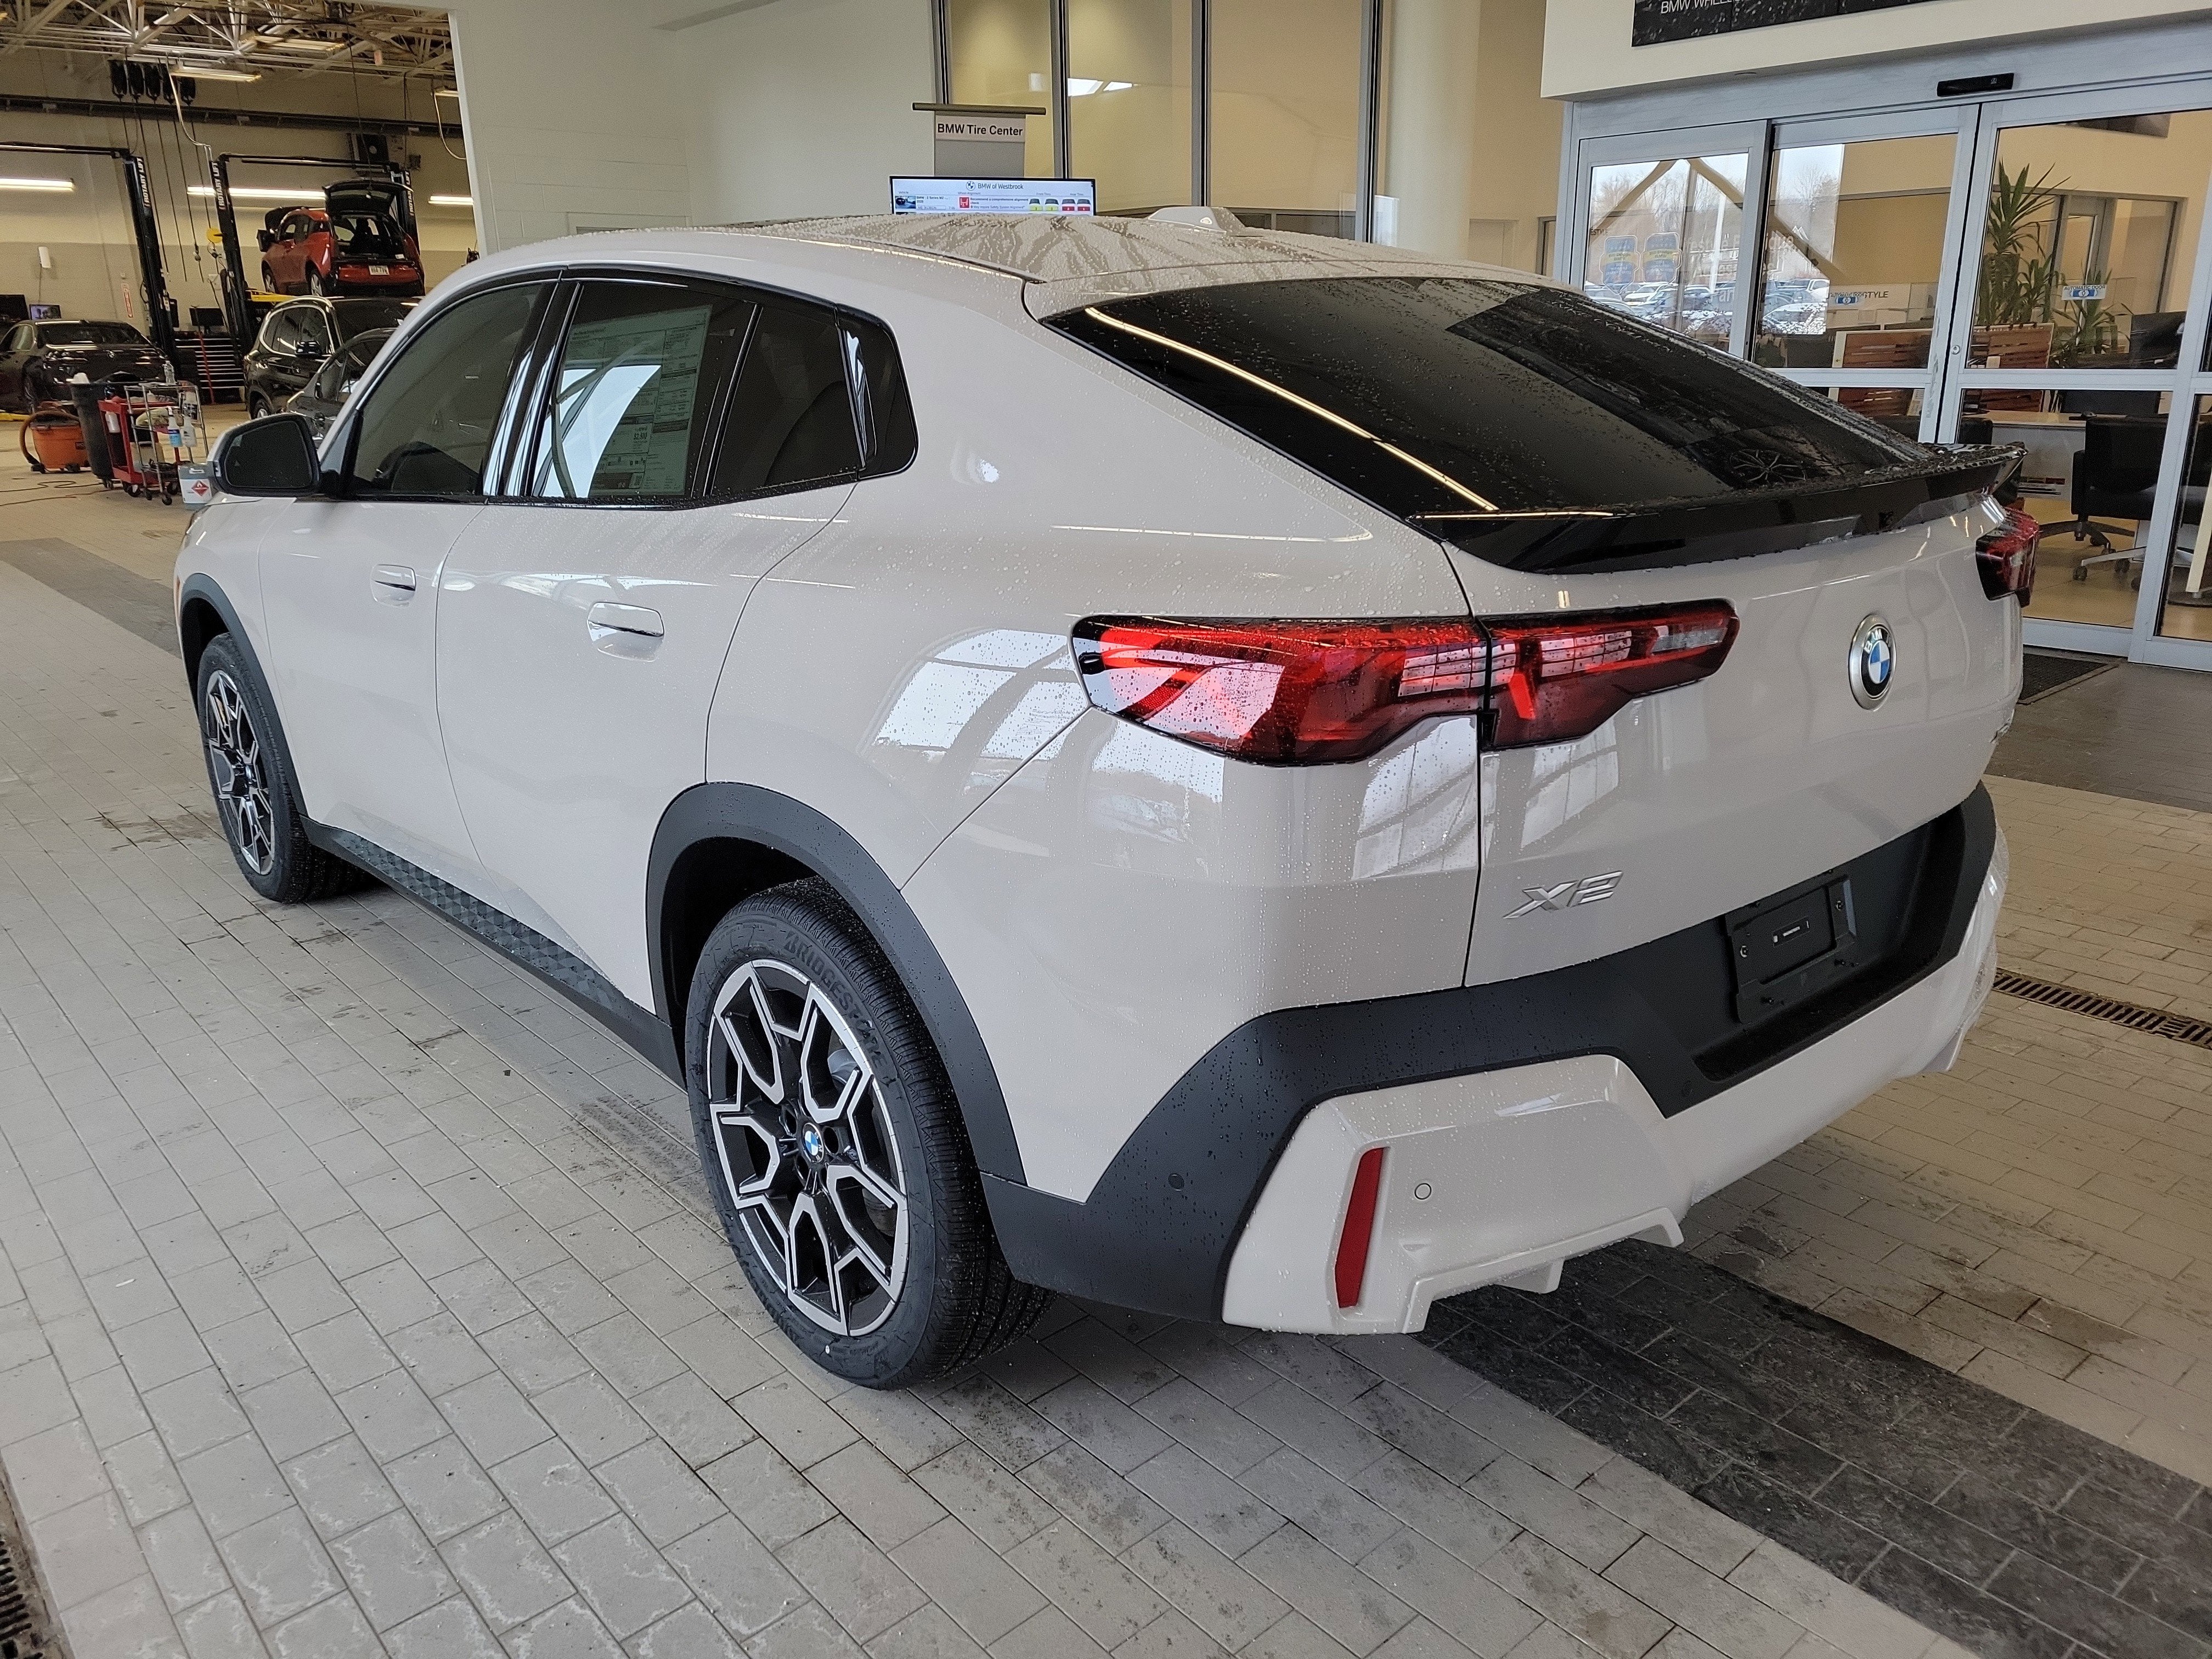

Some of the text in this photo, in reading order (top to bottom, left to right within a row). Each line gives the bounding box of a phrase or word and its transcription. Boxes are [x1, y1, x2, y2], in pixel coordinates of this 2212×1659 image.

[1661, 0, 1691, 14] BMW
[938, 123, 1023, 136] BMW Tire Center
[139, 174, 150, 203] ROTARY
[212, 162, 225, 206] ROTARY LIFT
[1864, 628, 1892, 655] BMW
[1502, 870, 1624, 919] X2
[783, 929, 888, 1069] BRIDGESTONE
